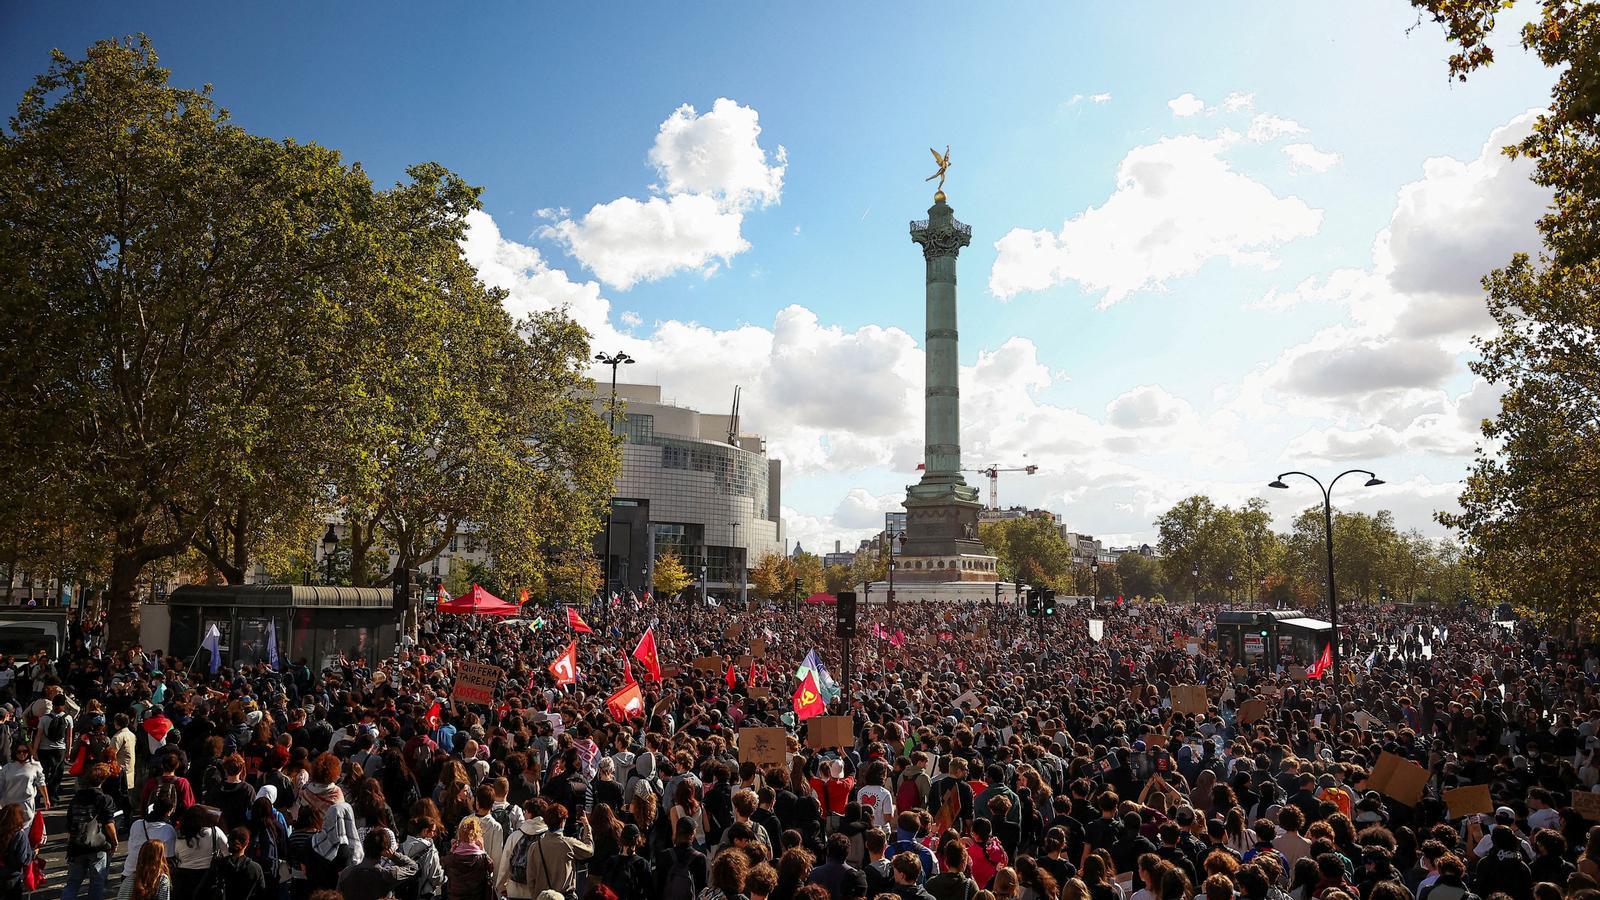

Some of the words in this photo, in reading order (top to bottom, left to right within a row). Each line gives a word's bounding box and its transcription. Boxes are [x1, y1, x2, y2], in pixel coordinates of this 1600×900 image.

[462, 664, 476, 673] QUI
[478, 666, 497, 678] FERA
[460, 672, 481, 685] TAIRE
[481, 678, 496, 688] LES
